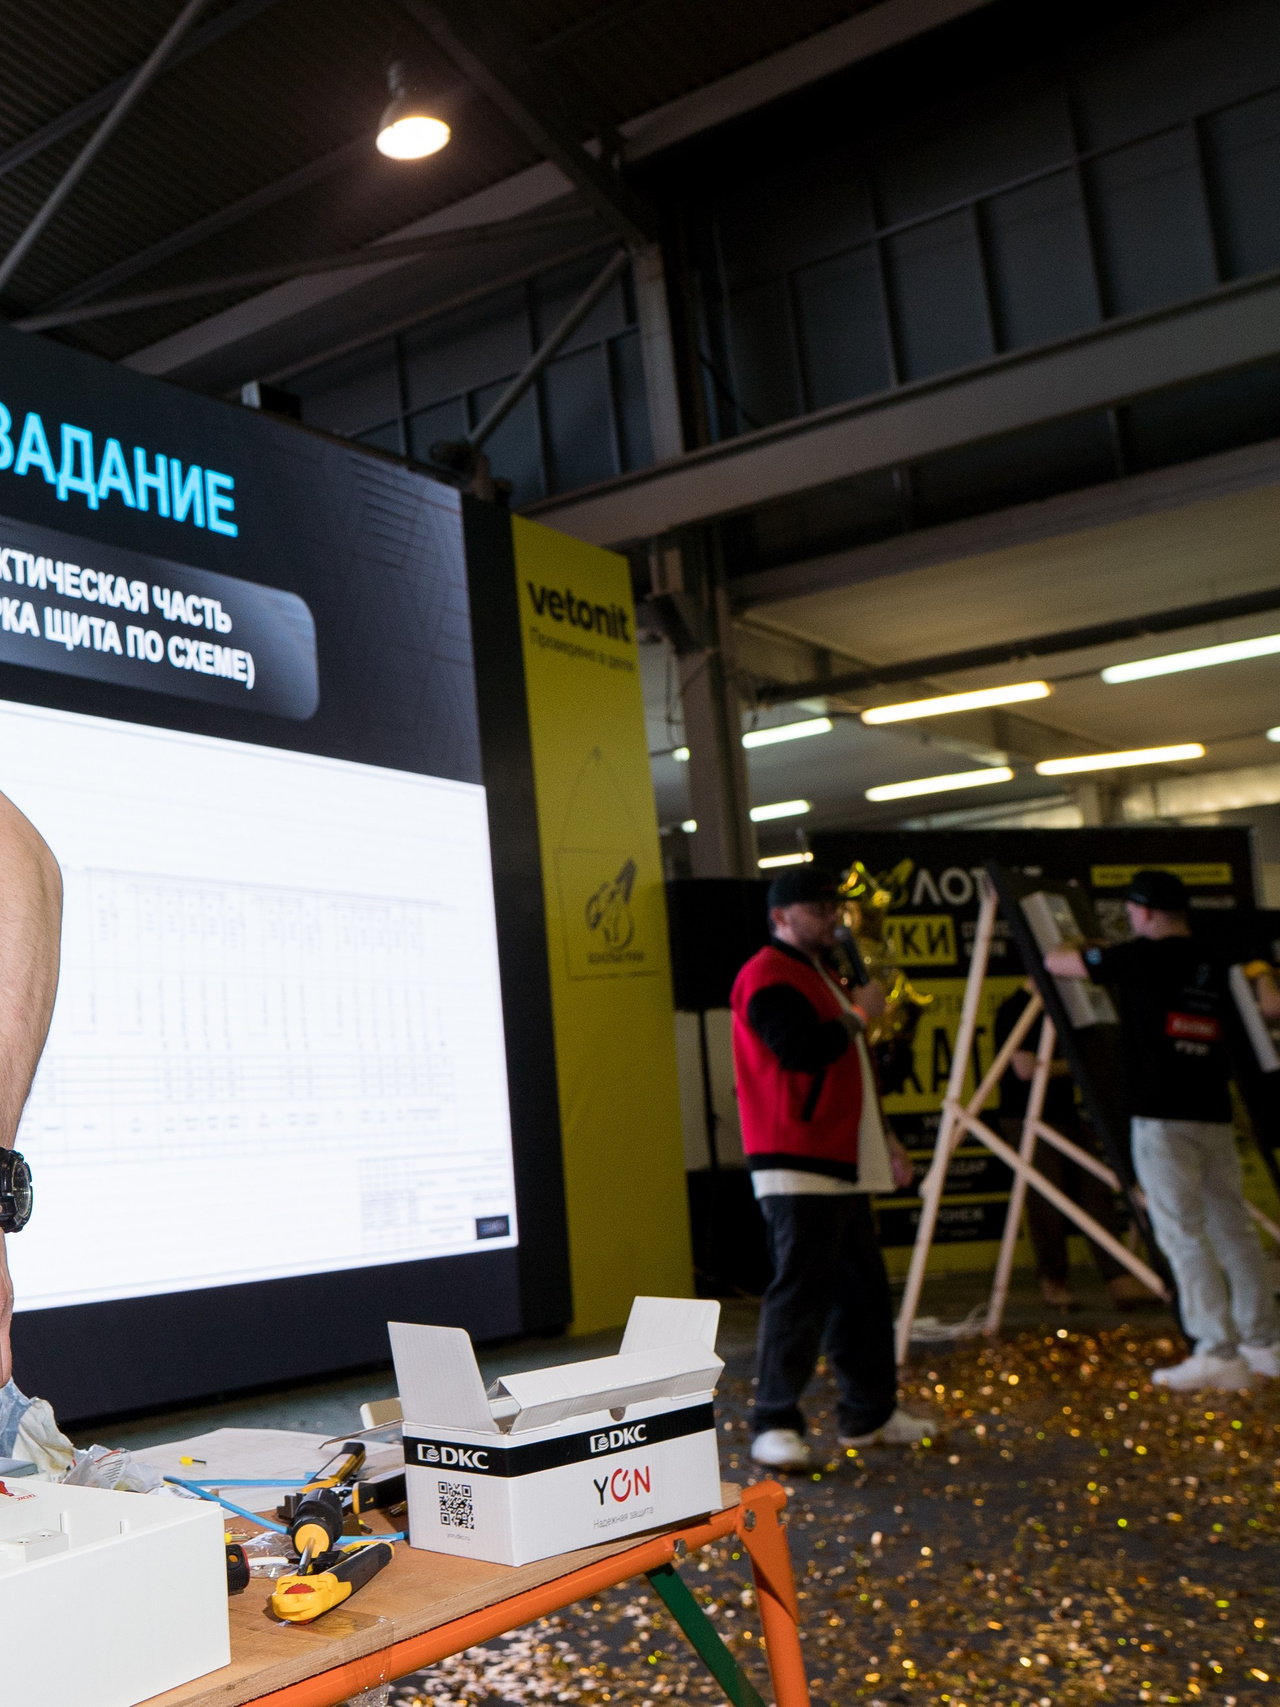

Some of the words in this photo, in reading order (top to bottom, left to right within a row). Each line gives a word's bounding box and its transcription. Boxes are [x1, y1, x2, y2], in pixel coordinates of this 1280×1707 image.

[152, 584, 233, 635] ЧАСТЬ
[527, 582, 632, 643] vetonit
[44, 606, 122, 656] ЩИТА
[125, 625, 164, 663] ПО
[167, 635, 256, 690] СХЕМЕ)
[440, 1446, 489, 1470] DKC
[609, 1423, 647, 1449] DKC
